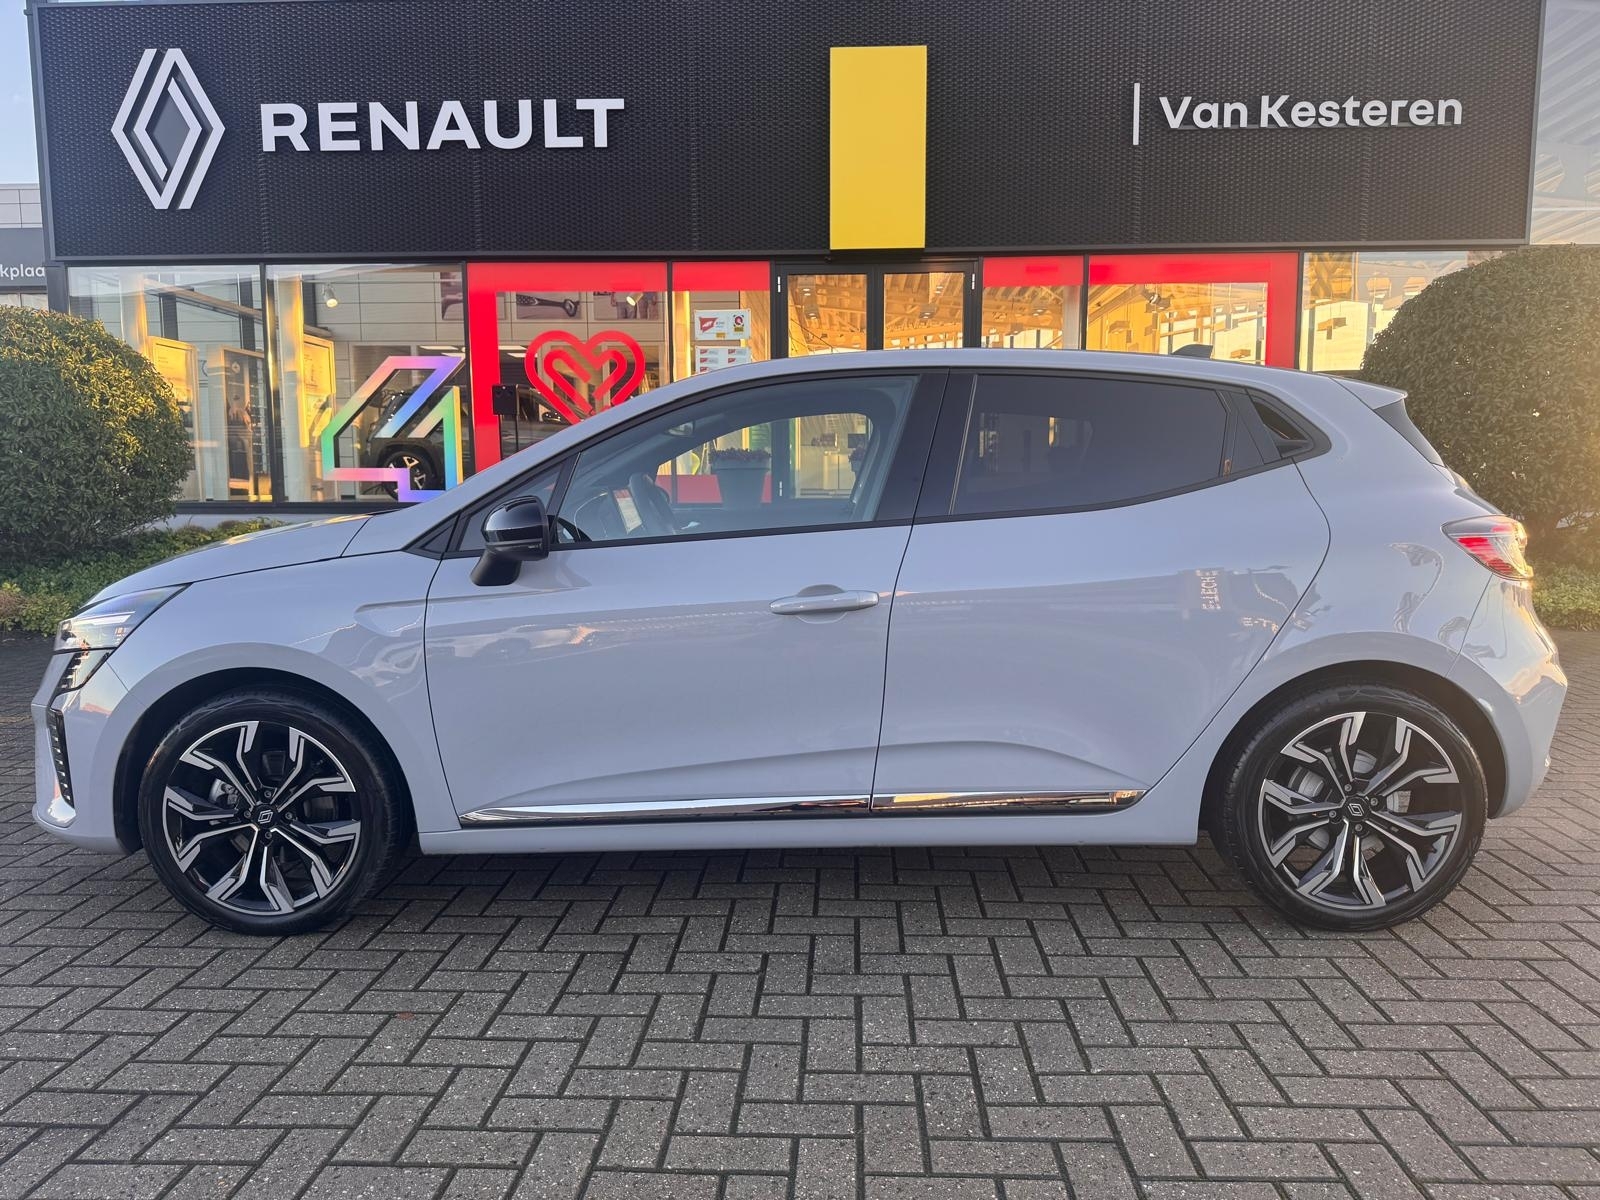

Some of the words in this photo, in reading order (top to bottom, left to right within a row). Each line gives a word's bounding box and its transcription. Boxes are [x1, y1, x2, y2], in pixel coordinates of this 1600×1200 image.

[260, 98, 625, 152] RENAULT
[1159, 96, 1248, 130] Van
[1260, 94, 1464, 129] Kesteren
